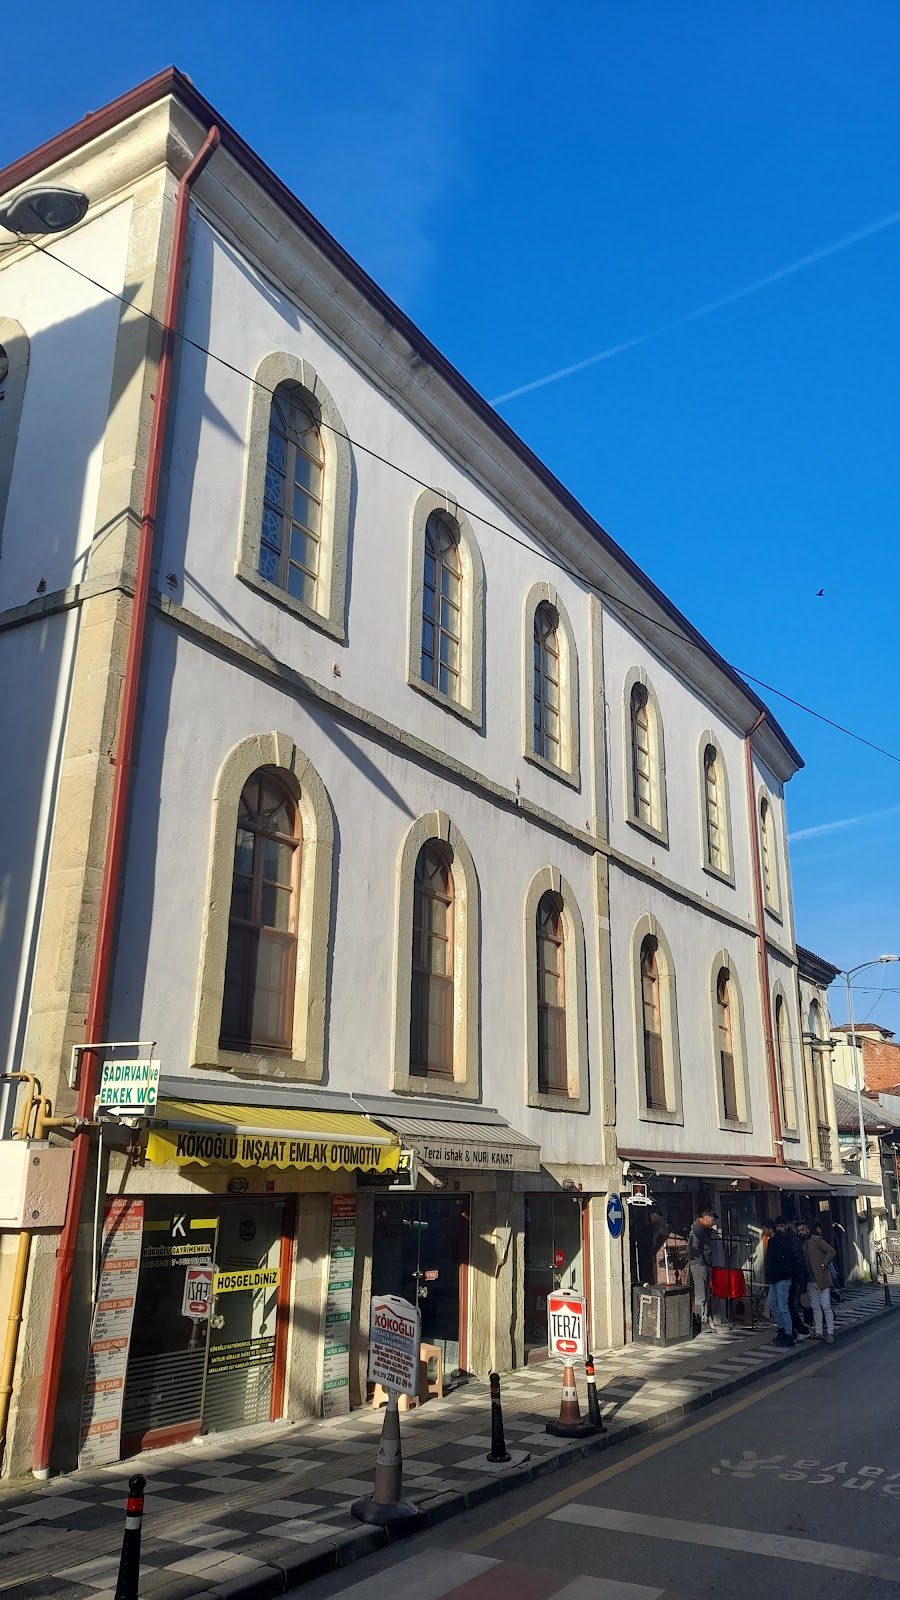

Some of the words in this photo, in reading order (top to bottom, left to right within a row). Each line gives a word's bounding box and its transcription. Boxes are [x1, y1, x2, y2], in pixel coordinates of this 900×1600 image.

[103, 1065, 149, 1085] ŞADIRVAN
[150, 1069, 158, 1081] ve
[101, 1088, 132, 1103] ERKEK
[137, 1087, 156, 1103] WC
[177, 1131, 238, 1159] KÖKOĞLU
[242, 1135, 286, 1165] İNŞAAT
[289, 1141, 327, 1163] EMLAK
[331, 1144, 381, 1166] OTOMOTİV
[424, 1146, 442, 1160] Terzi
[444, 1148, 463, 1162] ishak
[466, 1150, 471, 1162] &
[491, 1152, 513, 1165] KANAT
[375, 1314, 415, 1338] KÖKOĞLU
